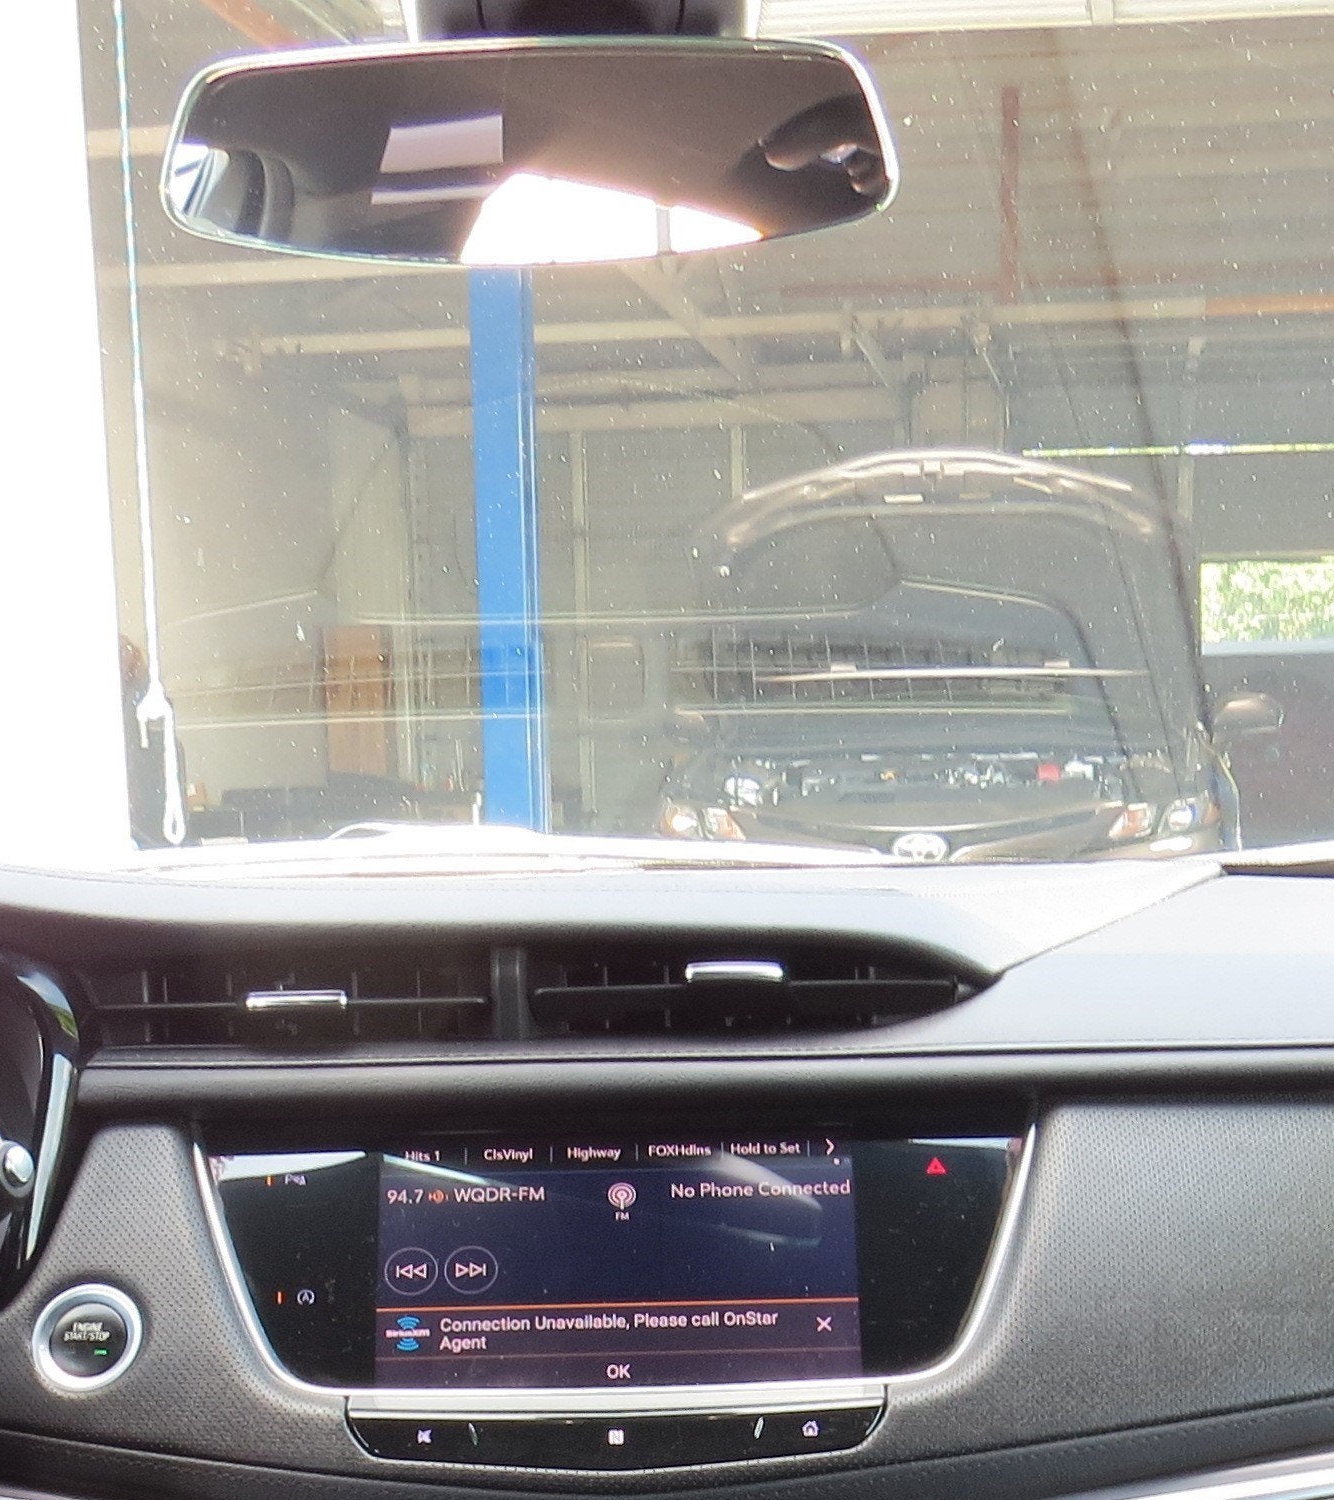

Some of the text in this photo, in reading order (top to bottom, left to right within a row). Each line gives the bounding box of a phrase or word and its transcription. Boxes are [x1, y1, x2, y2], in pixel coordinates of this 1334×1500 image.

[483, 1147, 534, 1163] ClsVinyl
[567, 1146, 622, 1161] Highway
[730, 1142, 801, 1155] Hold to Set
[386, 1188, 424, 1204] 94.7
[453, 1186, 546, 1203] WQDR-FM
[670, 1179, 851, 1199] No Phone Connected
[615, 1212, 630, 1221] FM
[439, 1310, 779, 1333] Connection Unavailable, Please call OnStar
[439, 1335, 487, 1353] Agent
[605, 1363, 632, 1380] OK
